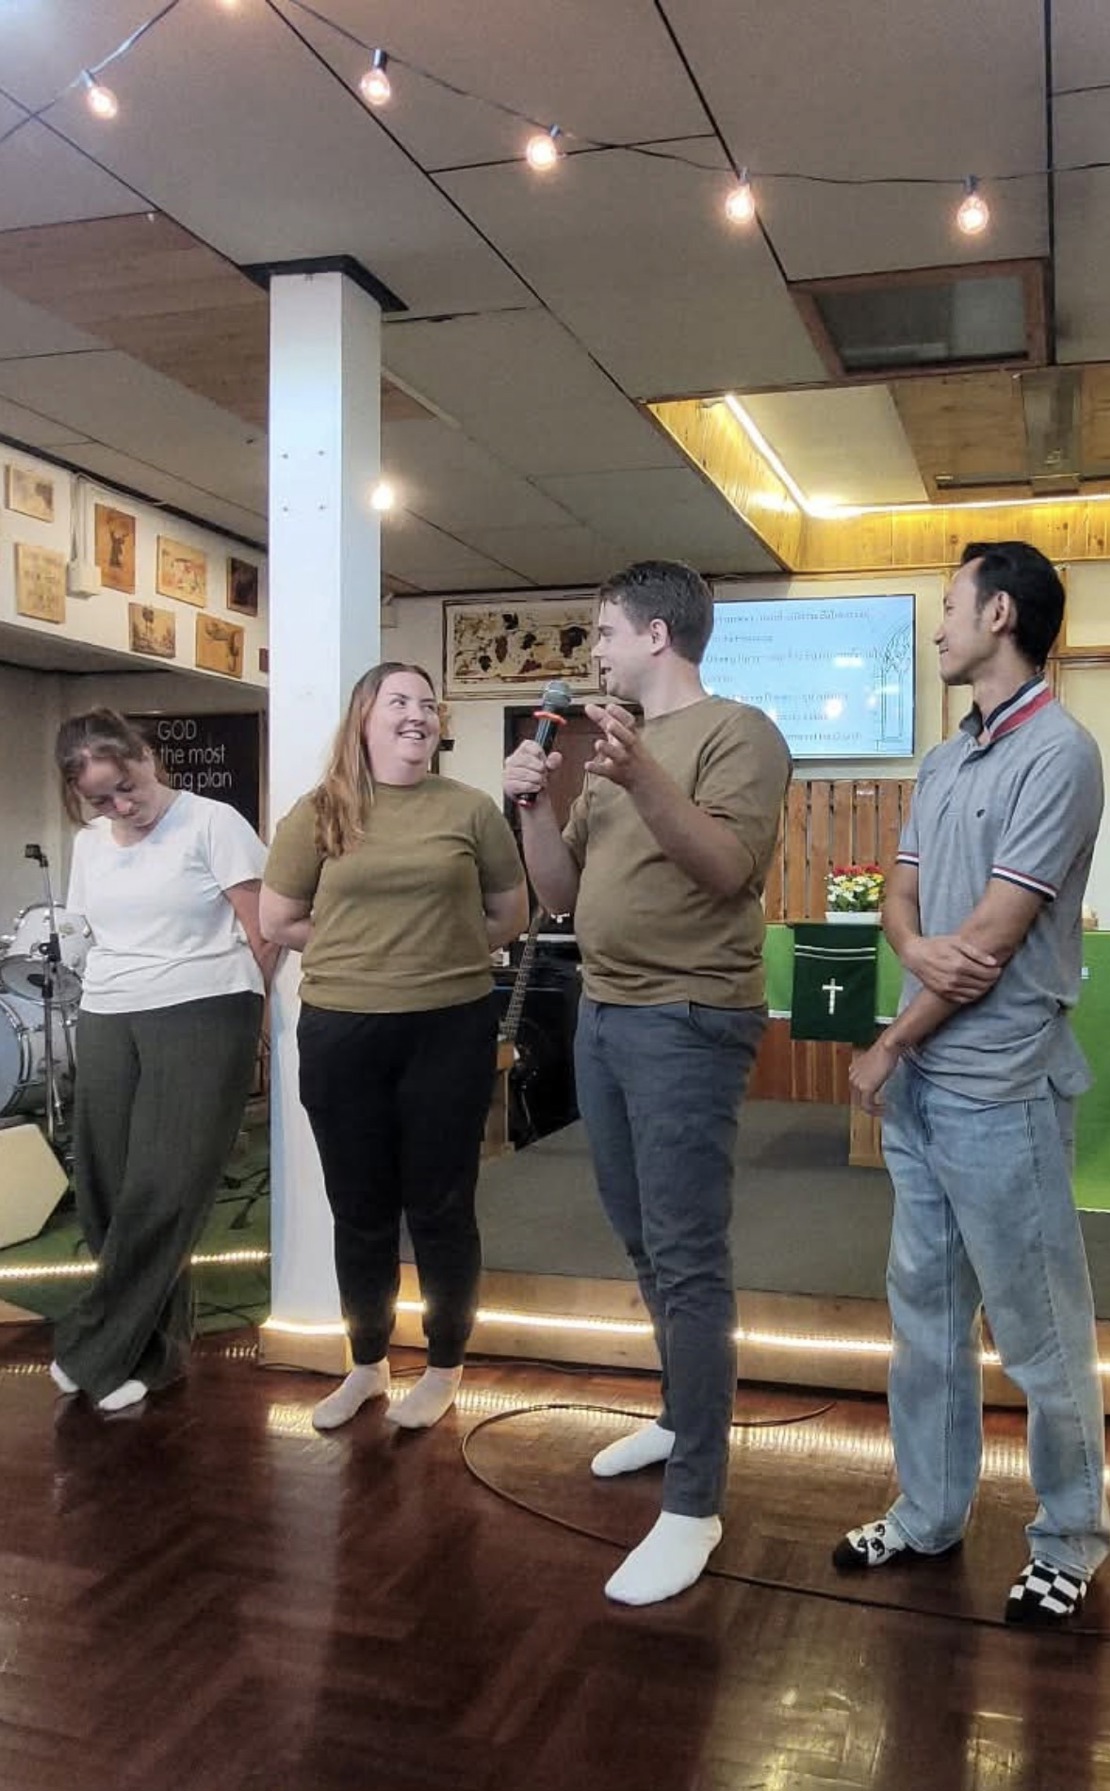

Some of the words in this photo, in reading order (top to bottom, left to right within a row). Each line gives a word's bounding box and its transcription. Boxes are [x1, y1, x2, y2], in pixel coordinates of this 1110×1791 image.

[157, 719, 197, 741] GOD
[160, 743, 184, 764] the
[188, 743, 225, 765] most
[169, 766, 193, 792] ing
[197, 766, 232, 792] plan
